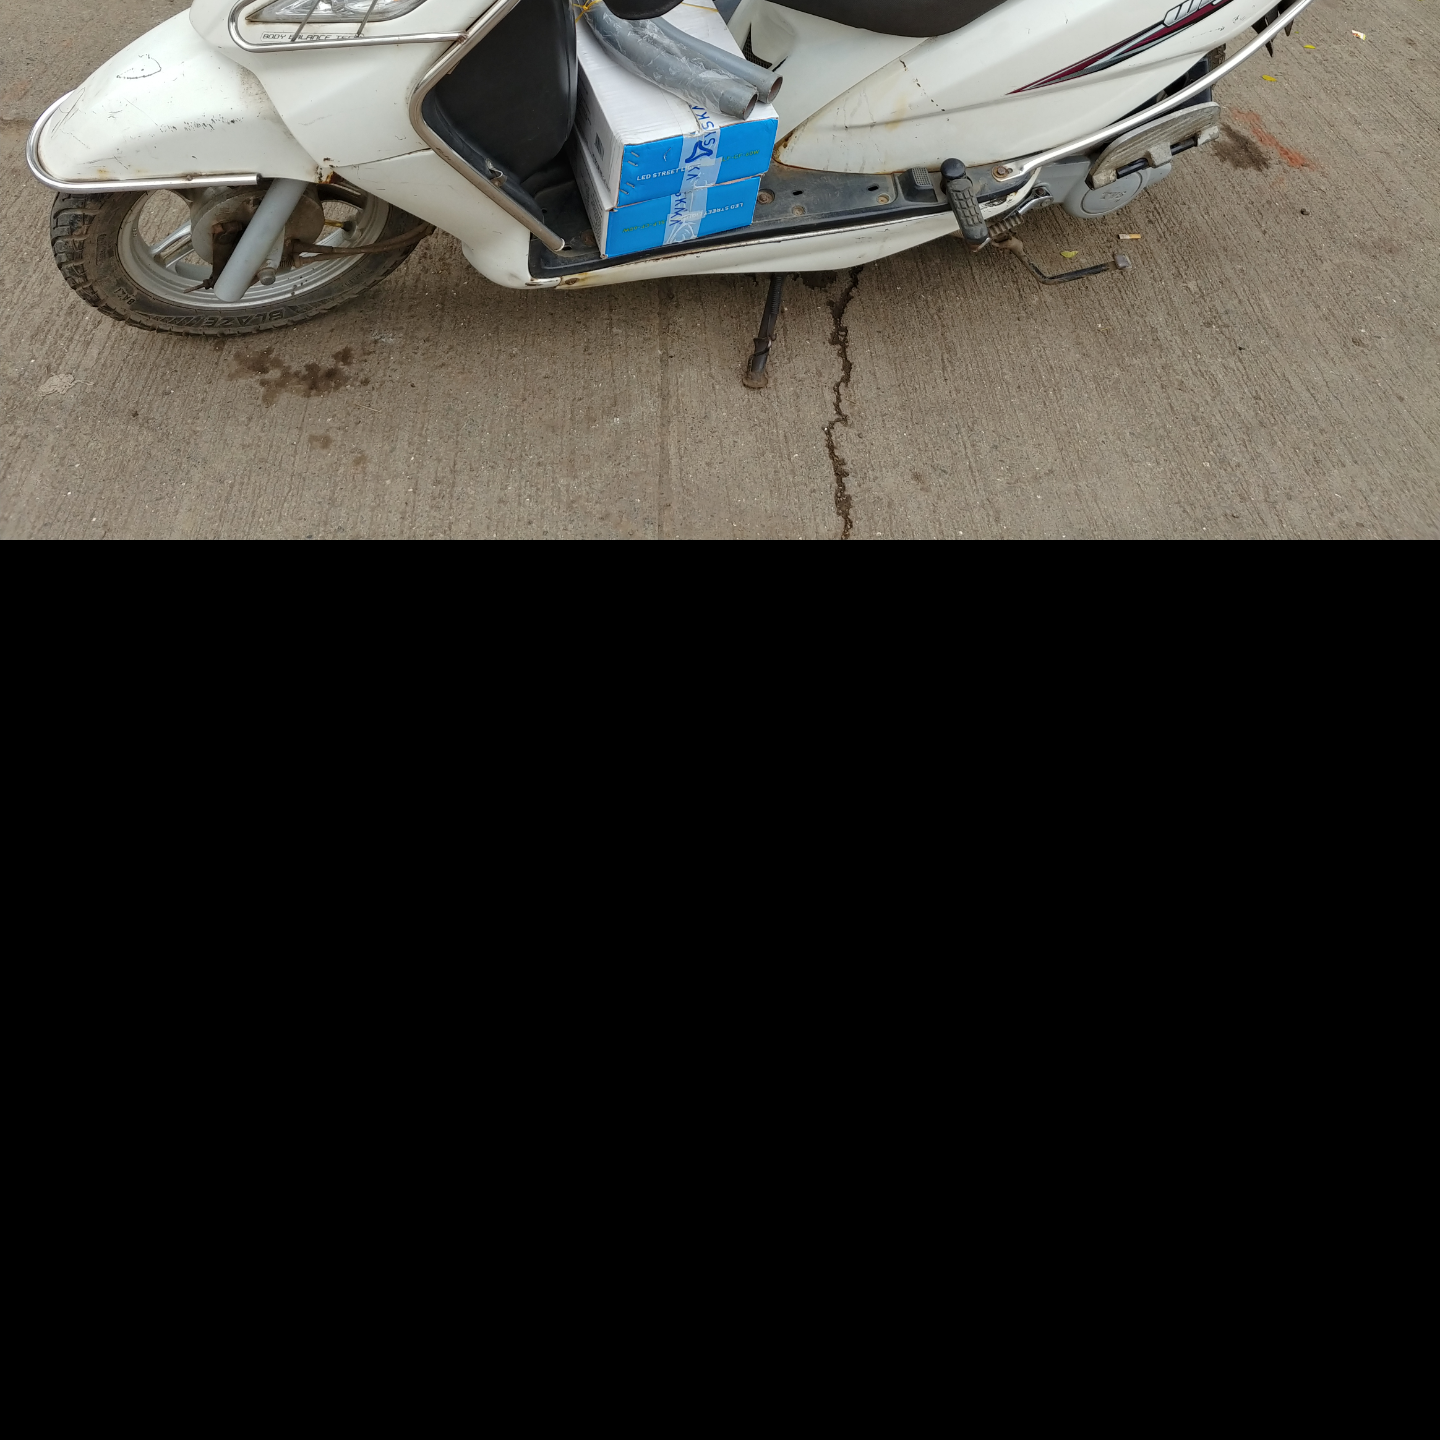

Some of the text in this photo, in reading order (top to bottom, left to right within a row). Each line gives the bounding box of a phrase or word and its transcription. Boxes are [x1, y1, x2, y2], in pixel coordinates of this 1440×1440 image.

[288, 33, 333, 41] BLANCE
[636, 173, 652, 181] LED
[652, 168, 681, 179] STREET
[703, 205, 730, 216] STREET
[730, 202, 744, 210] LED
